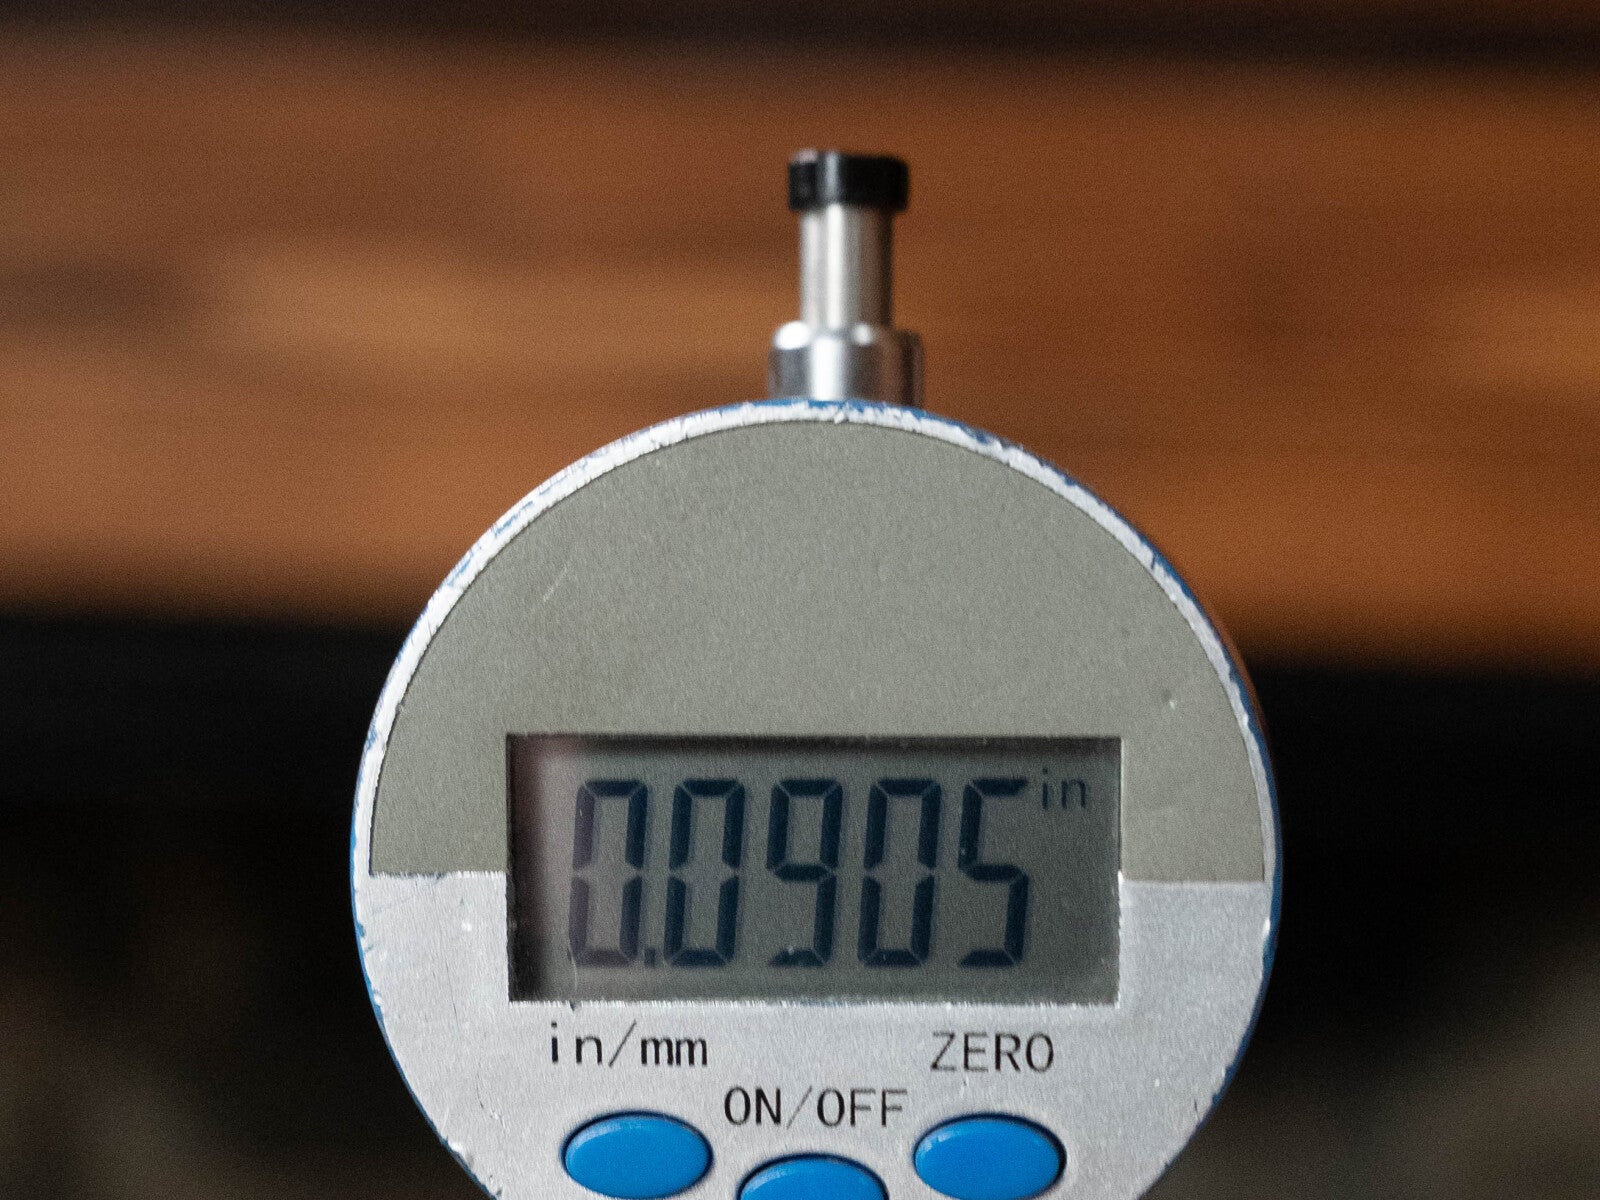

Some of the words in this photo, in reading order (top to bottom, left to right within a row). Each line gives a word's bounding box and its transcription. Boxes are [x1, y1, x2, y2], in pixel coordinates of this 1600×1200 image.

[568, 779, 1031, 969] 0.0905
[1040, 768, 1091, 812] in
[550, 1020, 709, 1068] in/mm
[929, 1030, 1055, 1073] ZERO
[723, 1084, 908, 1130] ON/OFF
